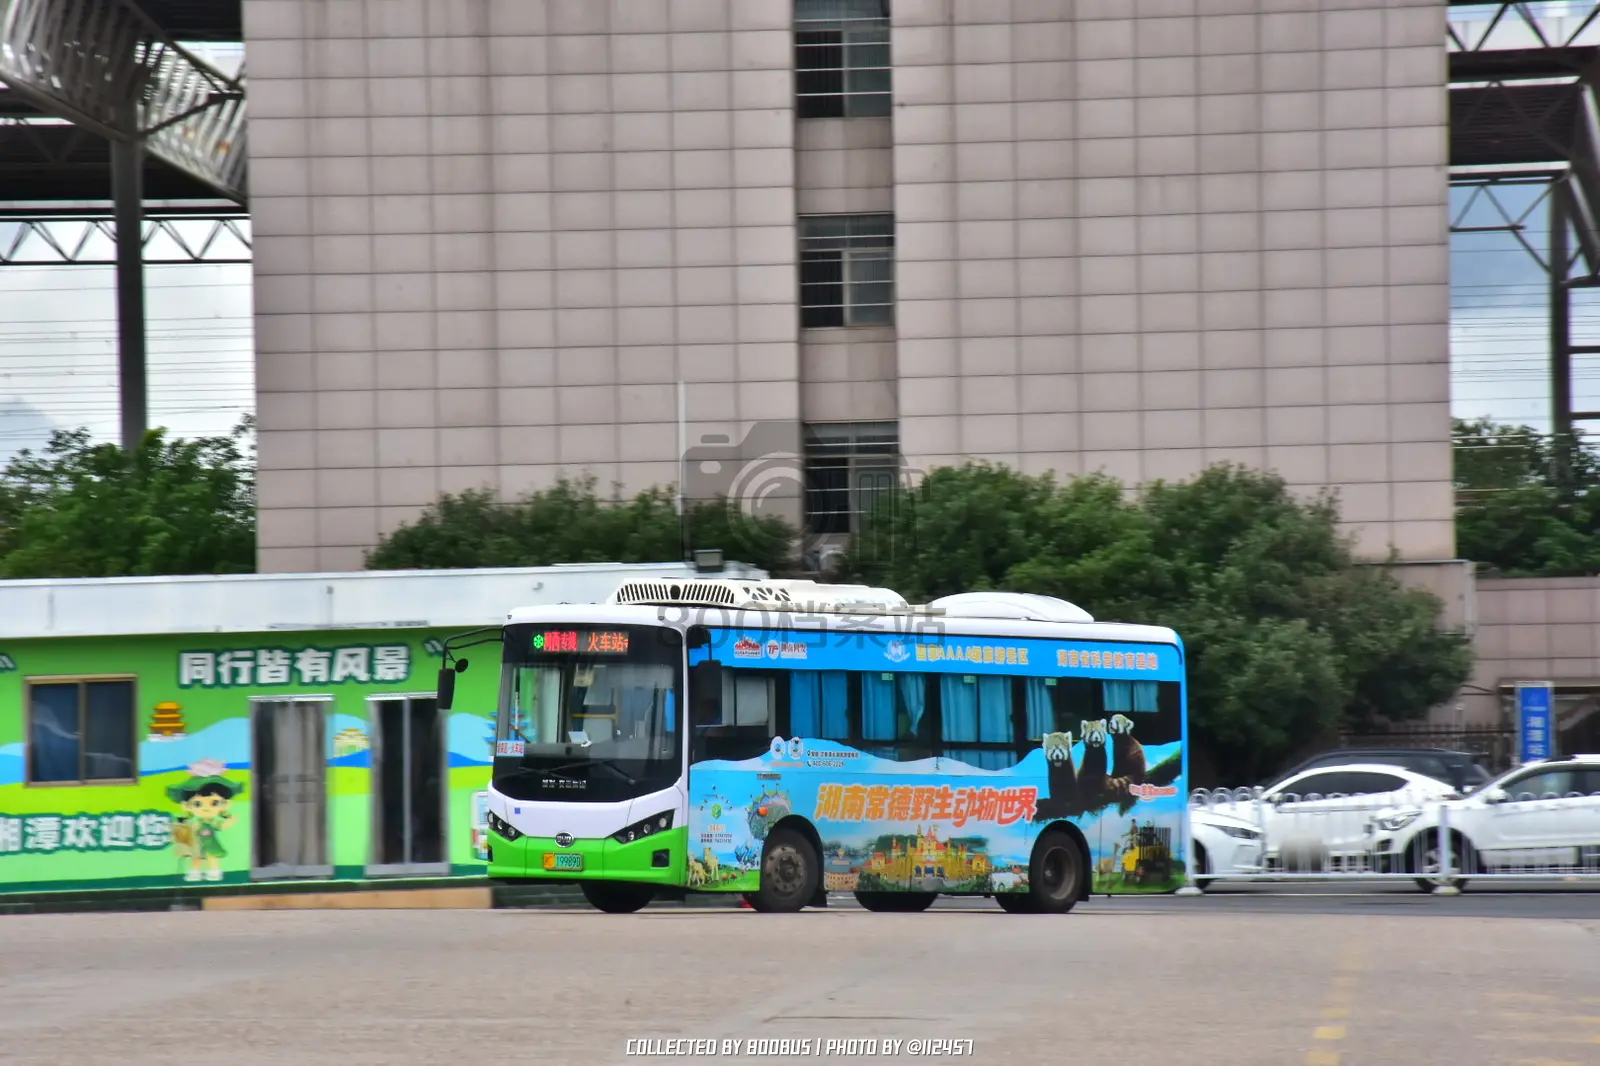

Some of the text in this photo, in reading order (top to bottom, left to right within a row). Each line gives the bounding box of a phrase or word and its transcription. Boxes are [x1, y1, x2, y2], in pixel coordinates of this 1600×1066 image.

[180, 645, 410, 686] 同行皆有风景
[815, 784, 1039, 828] 湖南常德野生动物世界
